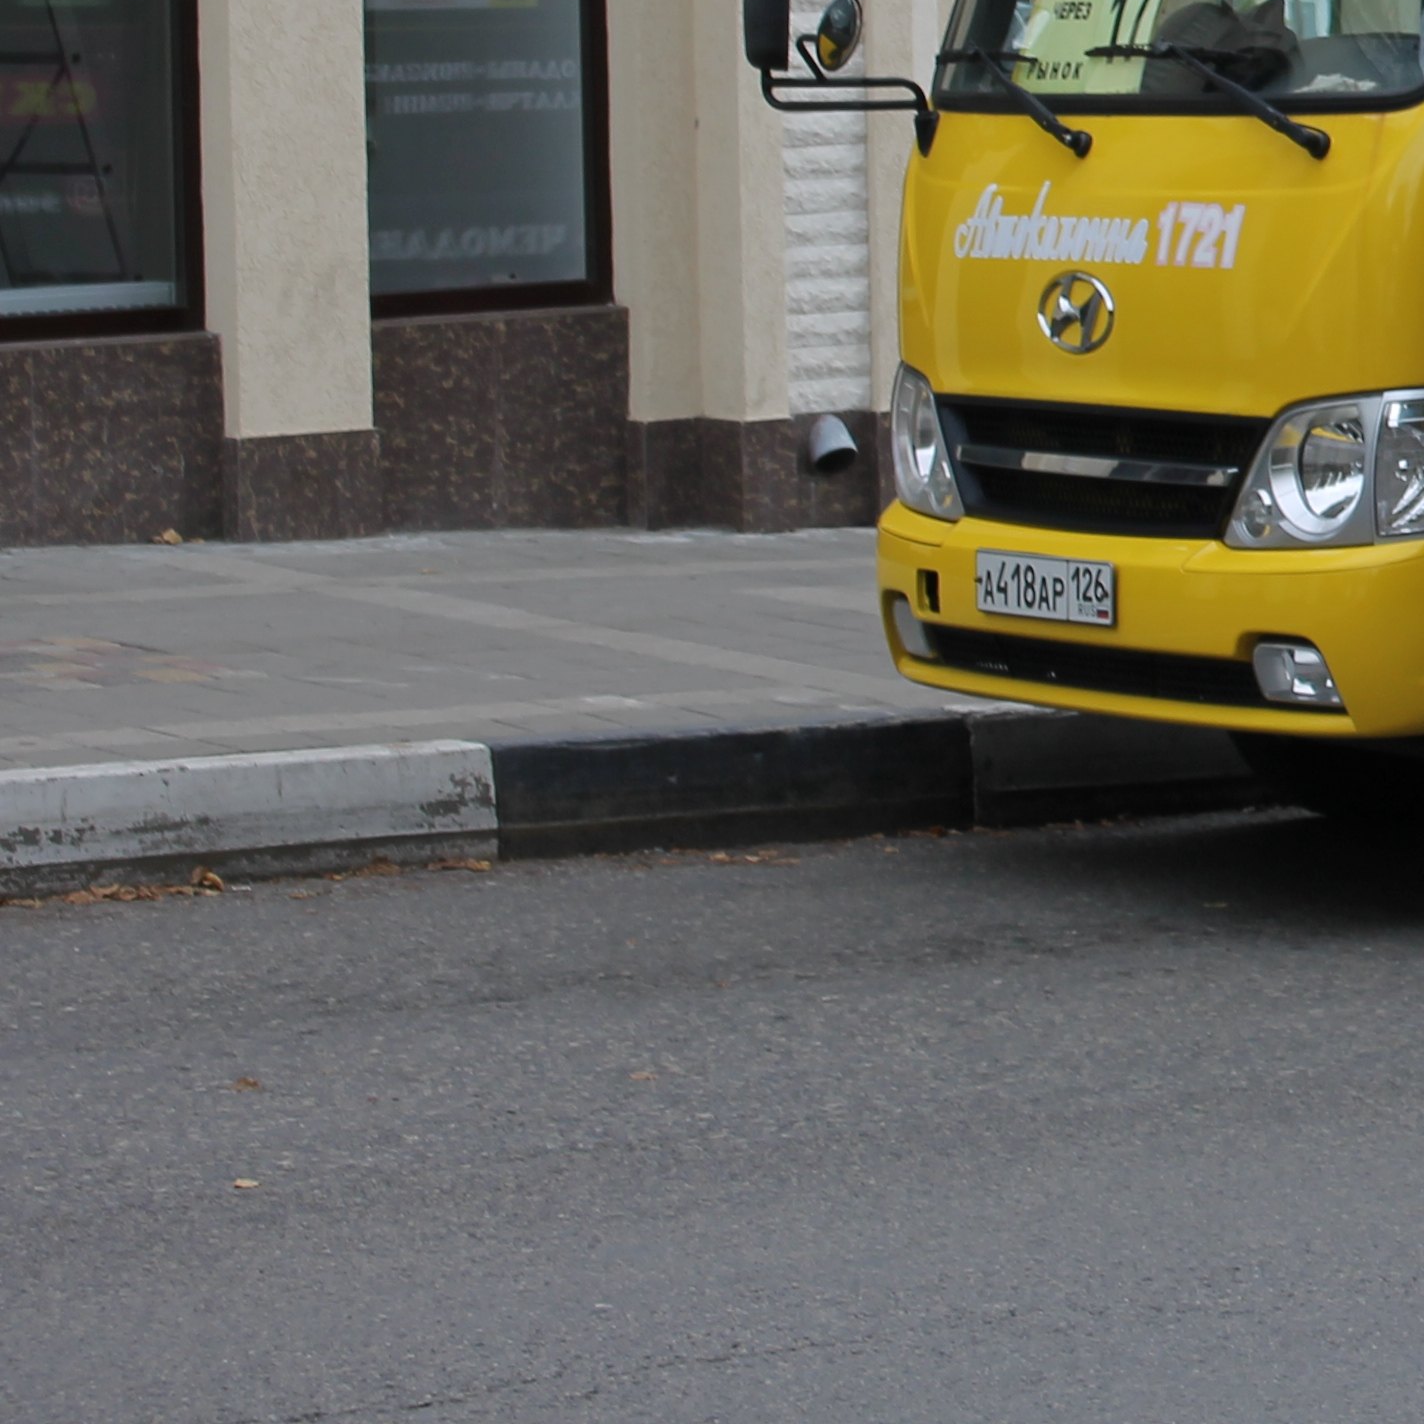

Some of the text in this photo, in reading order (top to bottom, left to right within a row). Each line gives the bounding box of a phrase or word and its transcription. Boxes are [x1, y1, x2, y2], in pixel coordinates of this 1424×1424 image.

[1053, 0, 1092, 21] ЧЕРЕЗ
[1027, 61, 1084, 80] РЫНОК
[954, 180, 1246, 269] Автоколонна 1721
[1071, 566, 1109, 603] 126
[1077, 603, 1097, 617] RUS
